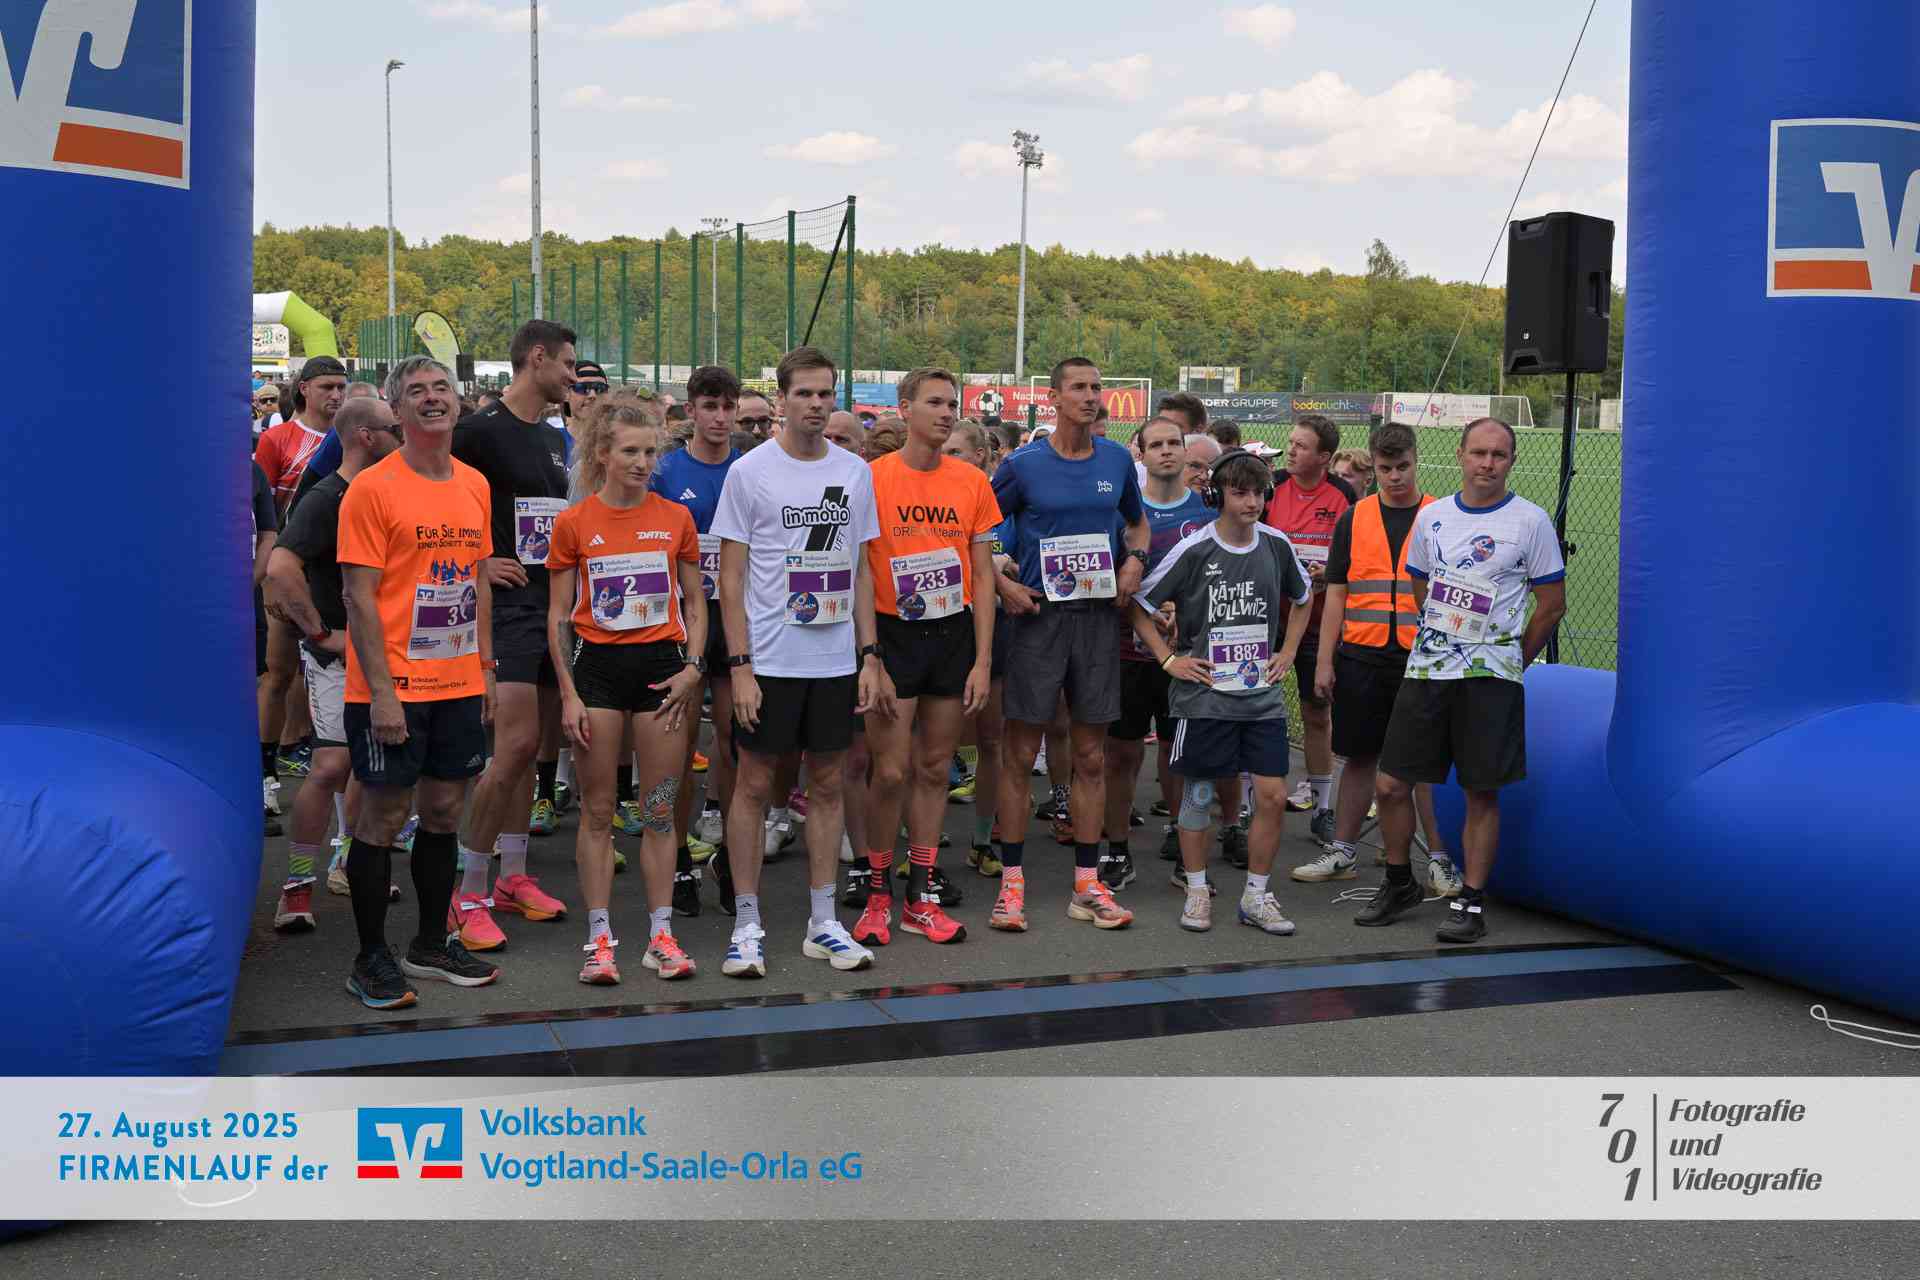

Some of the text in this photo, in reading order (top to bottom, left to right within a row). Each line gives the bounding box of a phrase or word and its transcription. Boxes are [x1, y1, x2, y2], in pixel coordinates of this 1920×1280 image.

[1230, 399, 1280, 408] GRUPPE
[897, 506, 959, 524] VOWA
[535, 517, 556, 534] 64
[636, 531, 672, 540] DATEC
[704, 553, 721, 571] 4
[1054, 553, 1101, 572] 1594
[623, 576, 638, 595] 2
[819, 572, 829, 592] 1
[914, 570, 949, 592] 233
[1208, 580, 1255, 605] KÄTHE
[1443, 586, 1474, 609] 193
[447, 607, 459, 626] 3
[1208, 598, 1267, 622] KOLLWITZ
[1221, 643, 1260, 663] 1882
